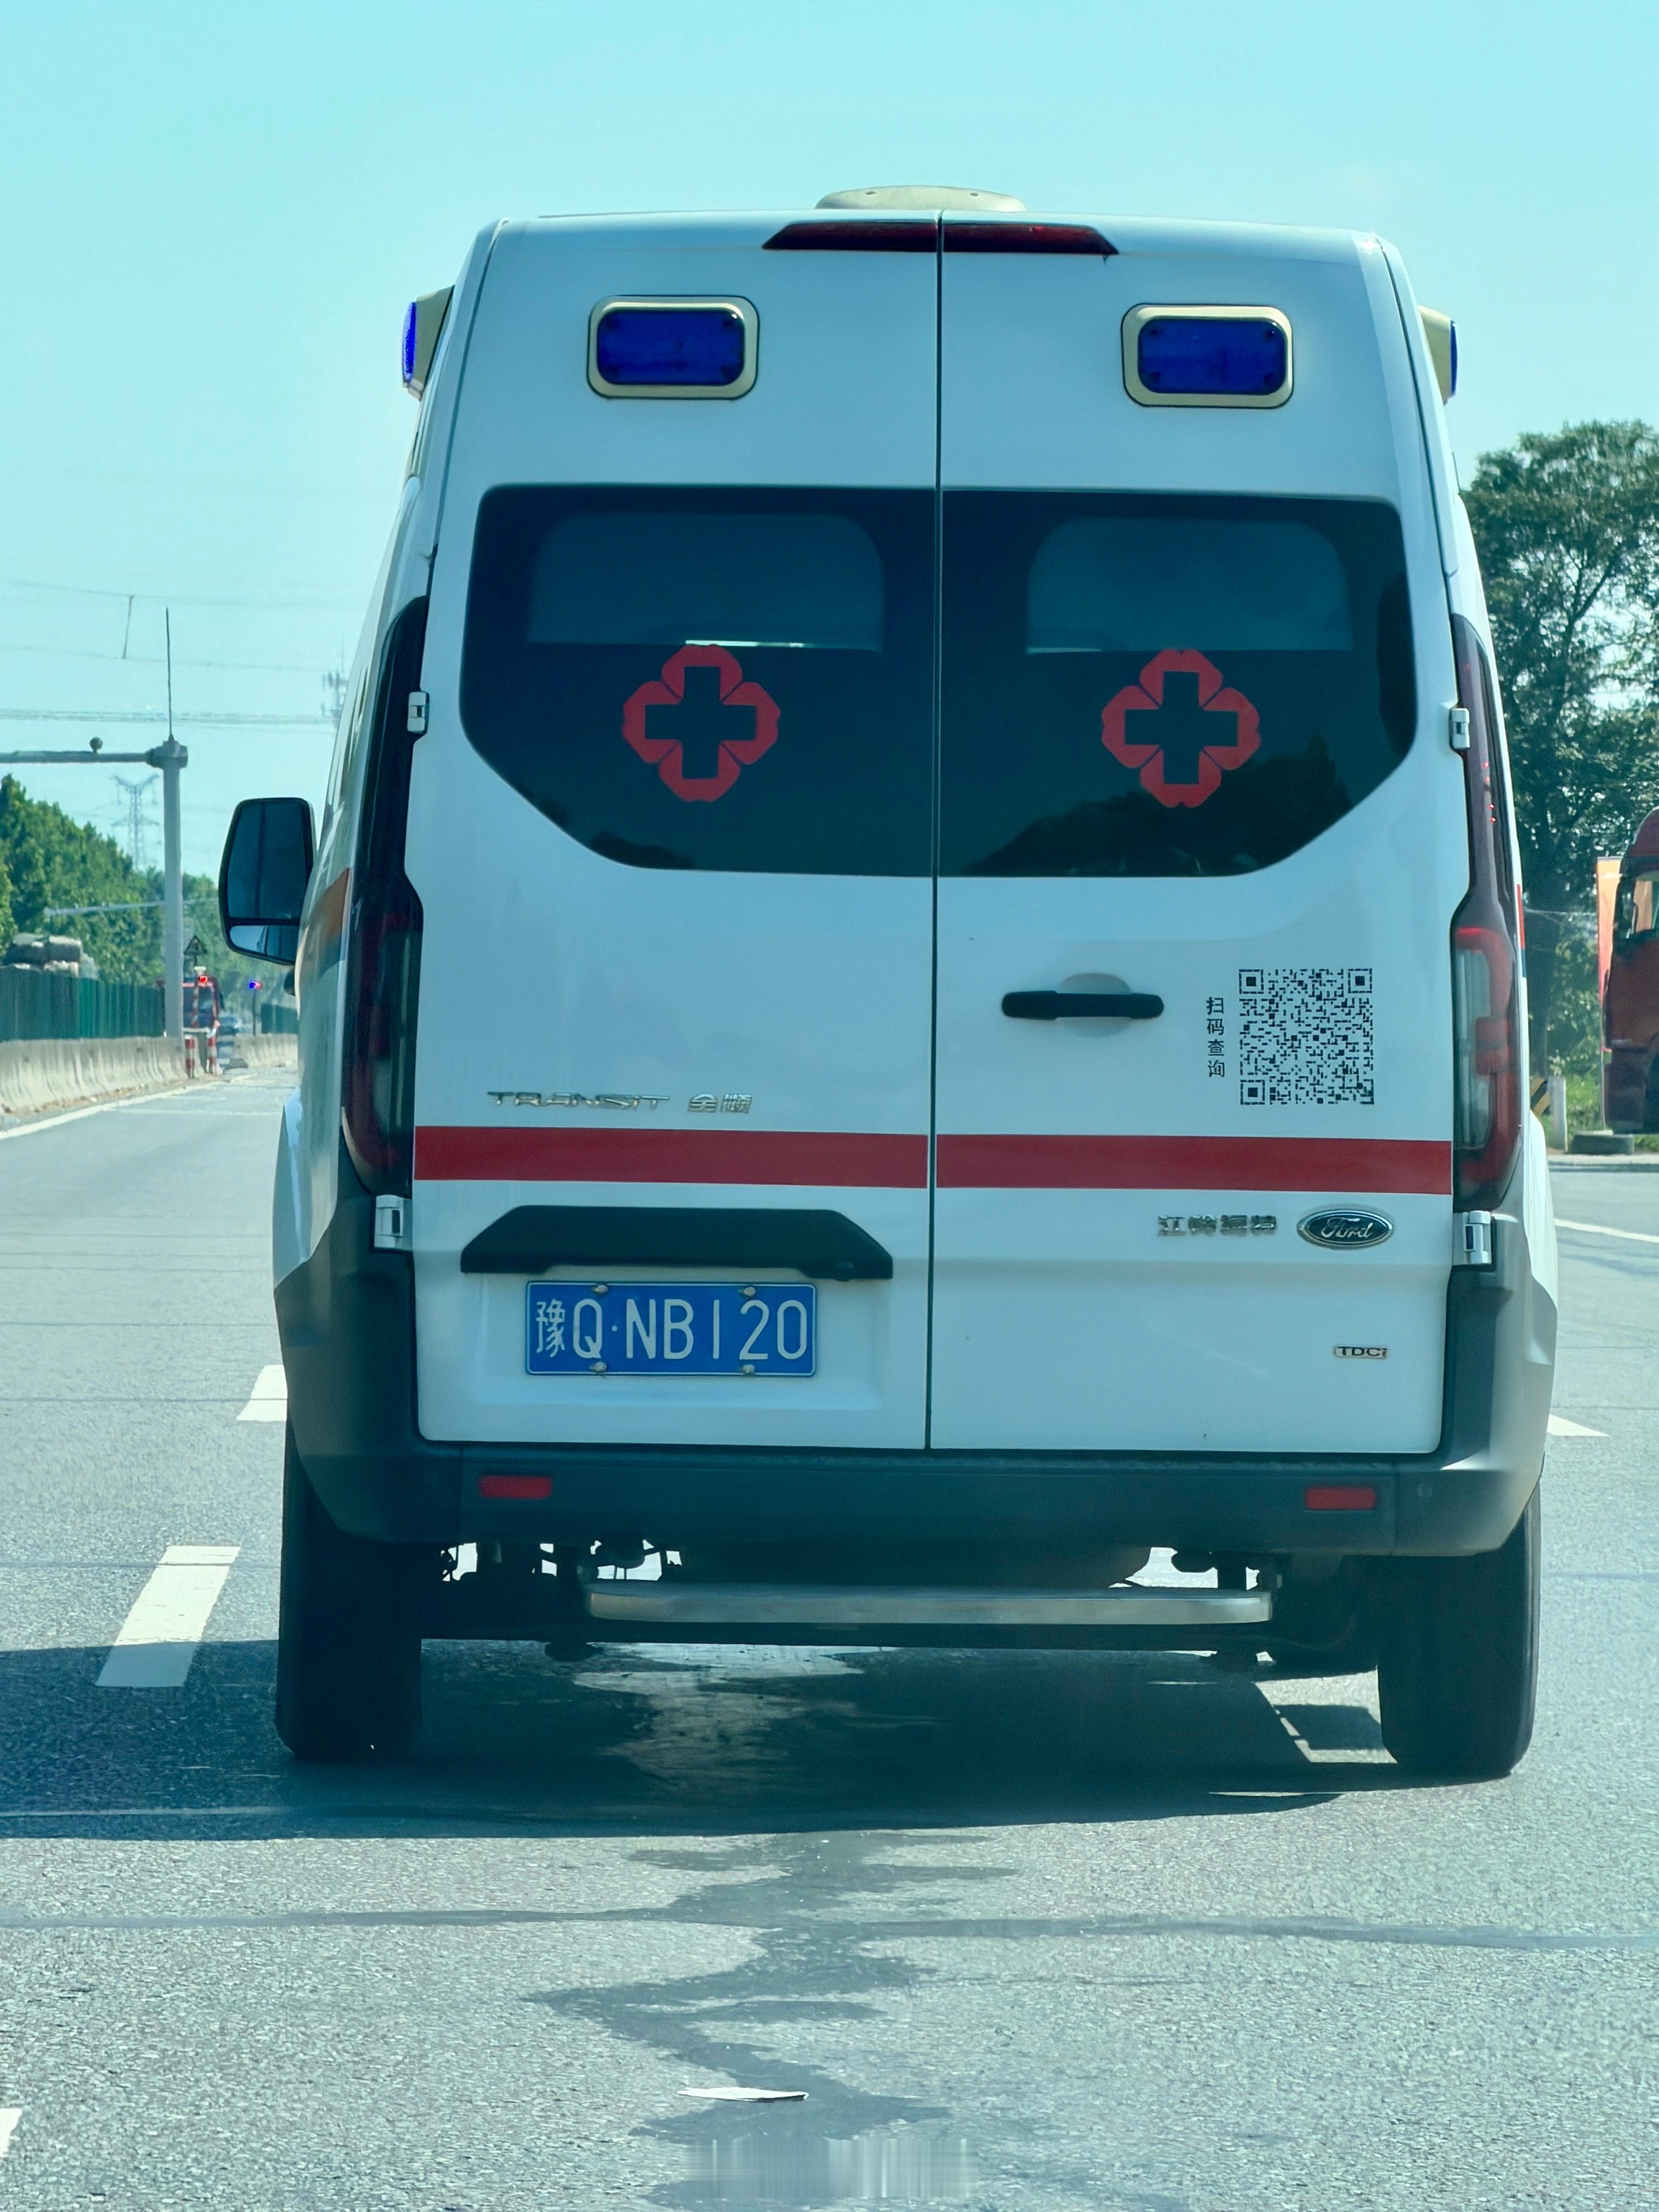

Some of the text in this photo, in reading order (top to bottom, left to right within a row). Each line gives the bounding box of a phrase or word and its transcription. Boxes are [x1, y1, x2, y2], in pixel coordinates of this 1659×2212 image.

[1206, 996, 1225, 1078] 扫码查询
[1321, 1217, 1373, 1239] Ford
